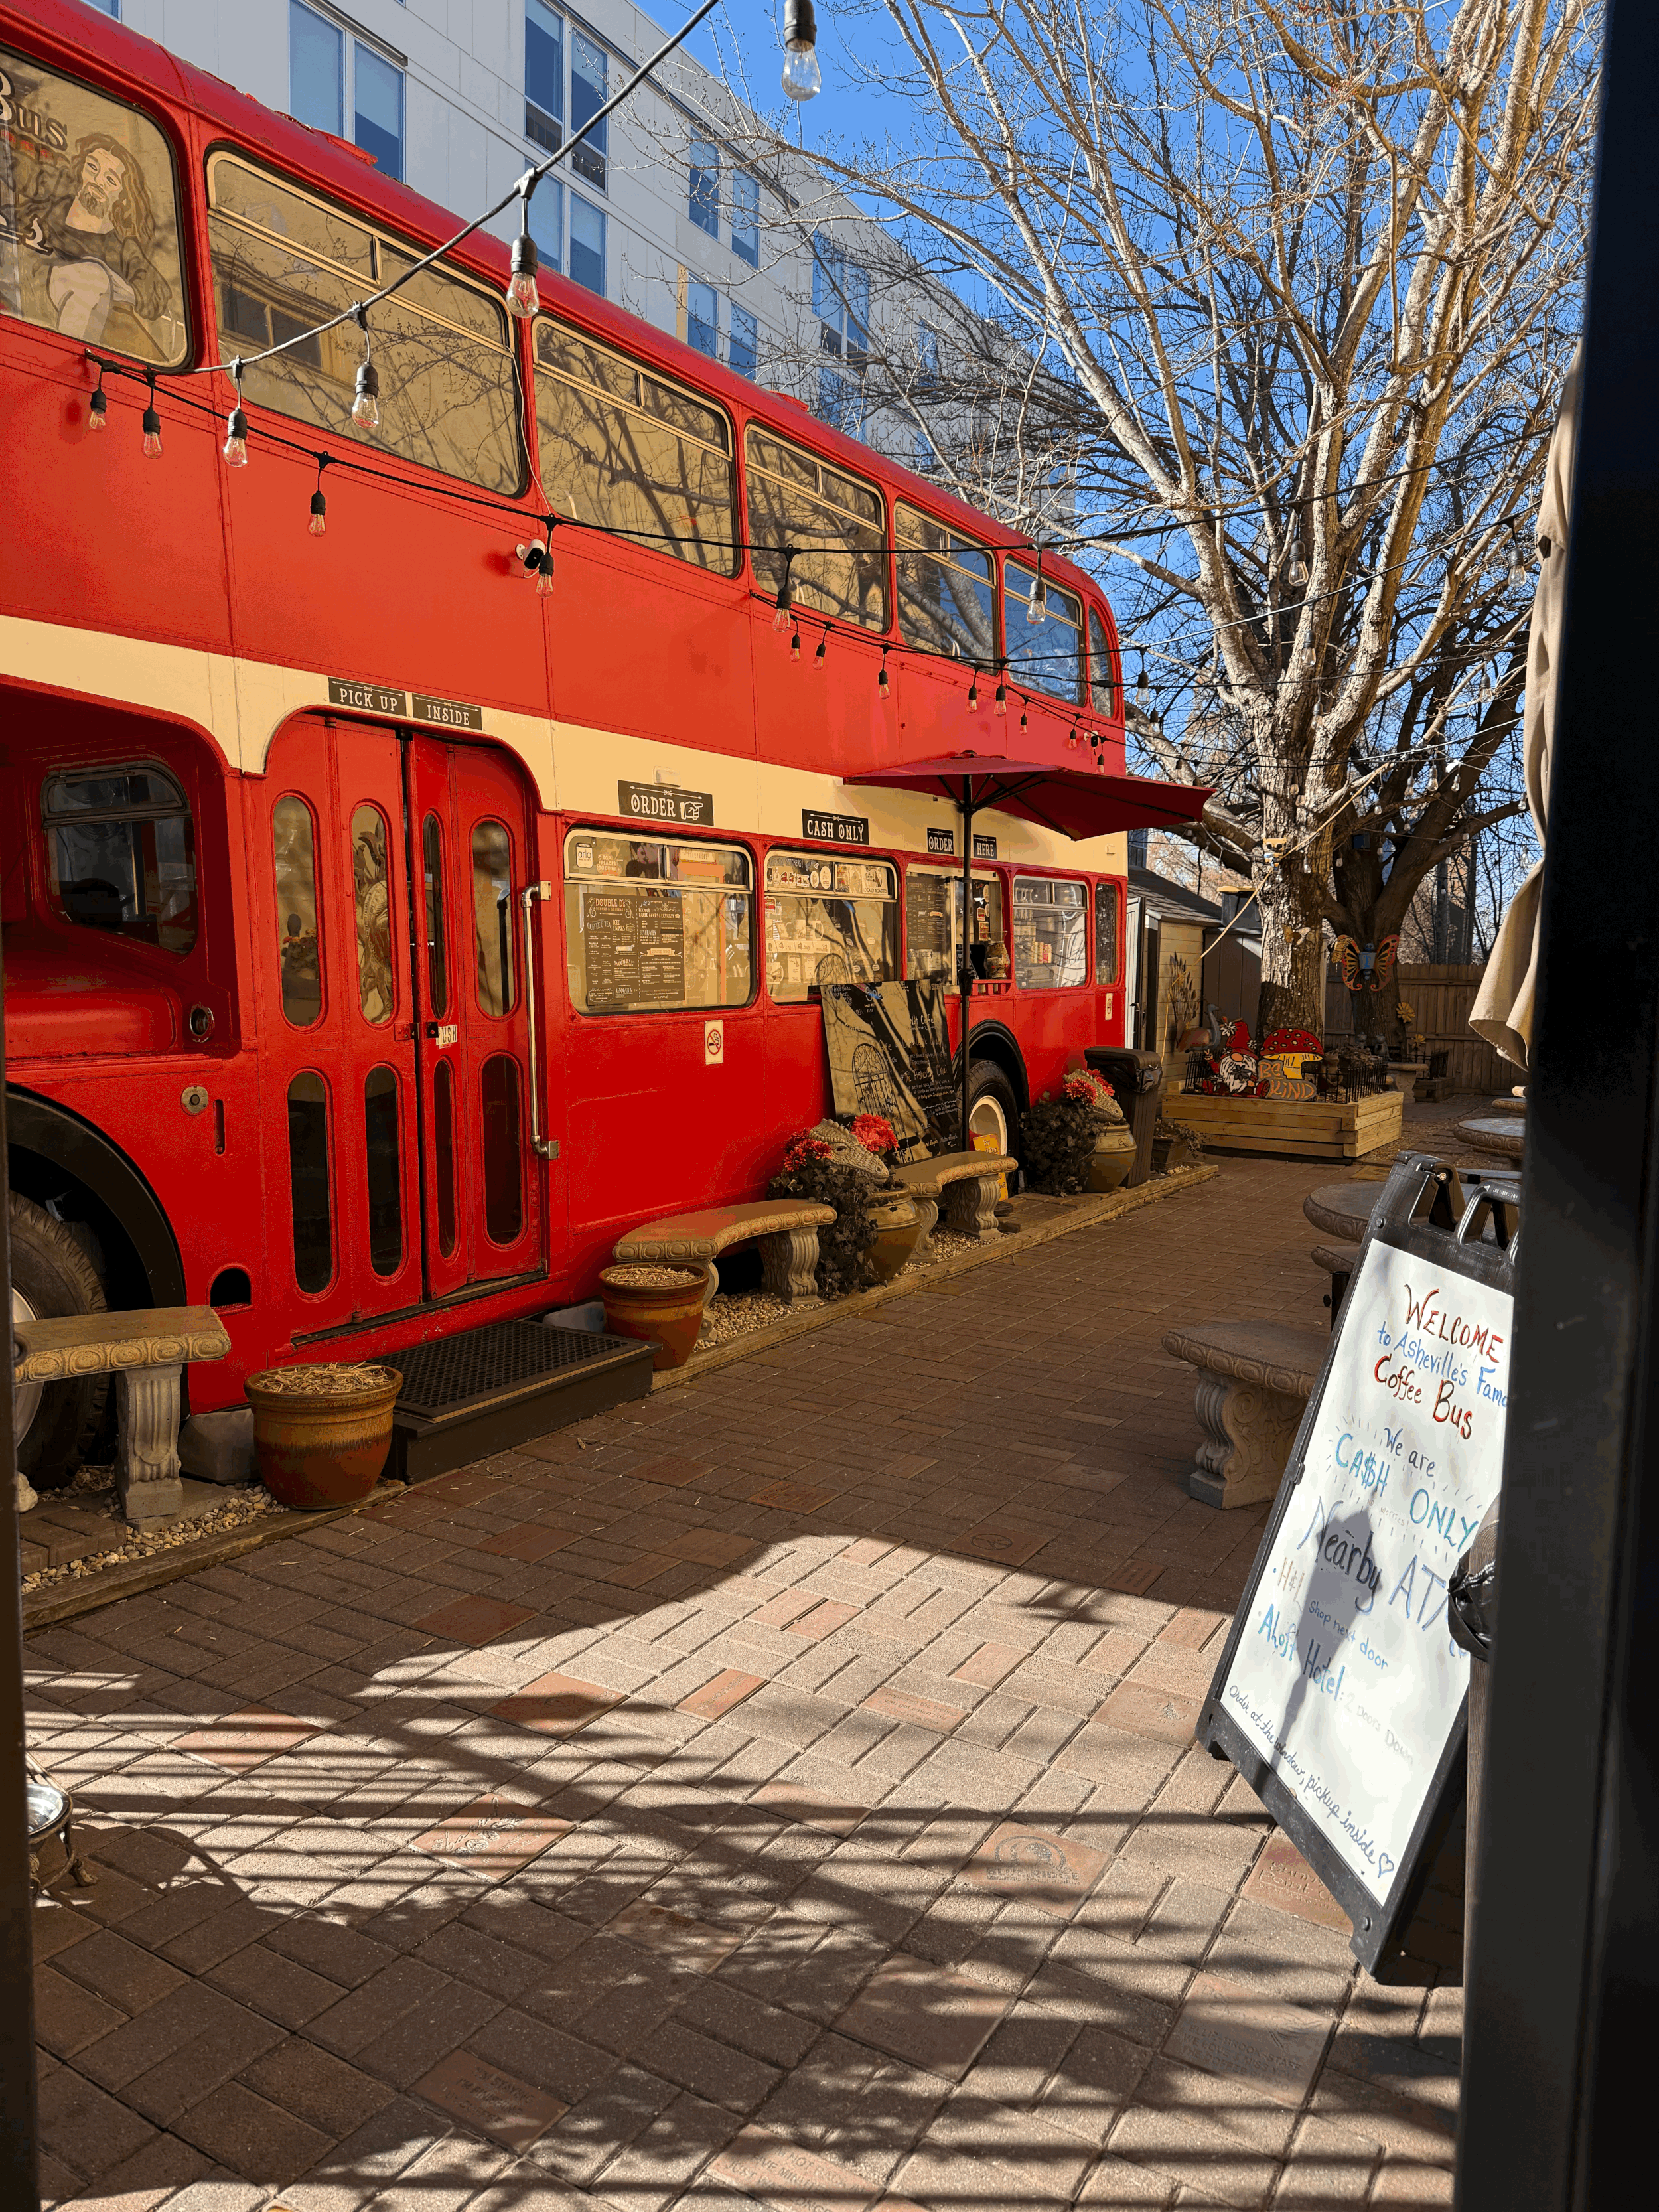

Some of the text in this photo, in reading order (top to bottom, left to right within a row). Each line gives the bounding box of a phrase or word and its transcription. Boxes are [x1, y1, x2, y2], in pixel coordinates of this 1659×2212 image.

[339, 688, 398, 712] PICK UP
[427, 704, 470, 726] INSIDE
[630, 793, 677, 818] ORDER
[807, 819, 864, 842] CASH ONLY
[578, 849, 591, 859] arlo
[928, 836, 954, 852] ORDER
[977, 842, 995, 857] HERE
[595, 898, 618, 907] DOUBLE
[438, 1025, 457, 1043] USH
[1404, 1283, 1504, 1364] WELCOME
[1377, 1321, 1392, 1347] to
[1393, 1331, 1469, 1387] Asheville's
[1374, 1353, 1473, 1441] Coffee Bus
[1383, 1427, 1436, 1477] We are
[1409, 1488, 1479, 1553] ONLY
[1296, 1495, 1382, 1616] Nearby
[1309, 1600, 1331, 1626] Shop
[1333, 1619, 1356, 1644] next
[1360, 1637, 1388, 1670] door
[1229, 1685, 1250, 1714] Order
[1250, 1711, 1263, 1727] at
[1260, 1719, 1275, 1744] the
[1303, 1774, 1340, 1819] pickup
[1339, 1810, 1376, 1865] inside
